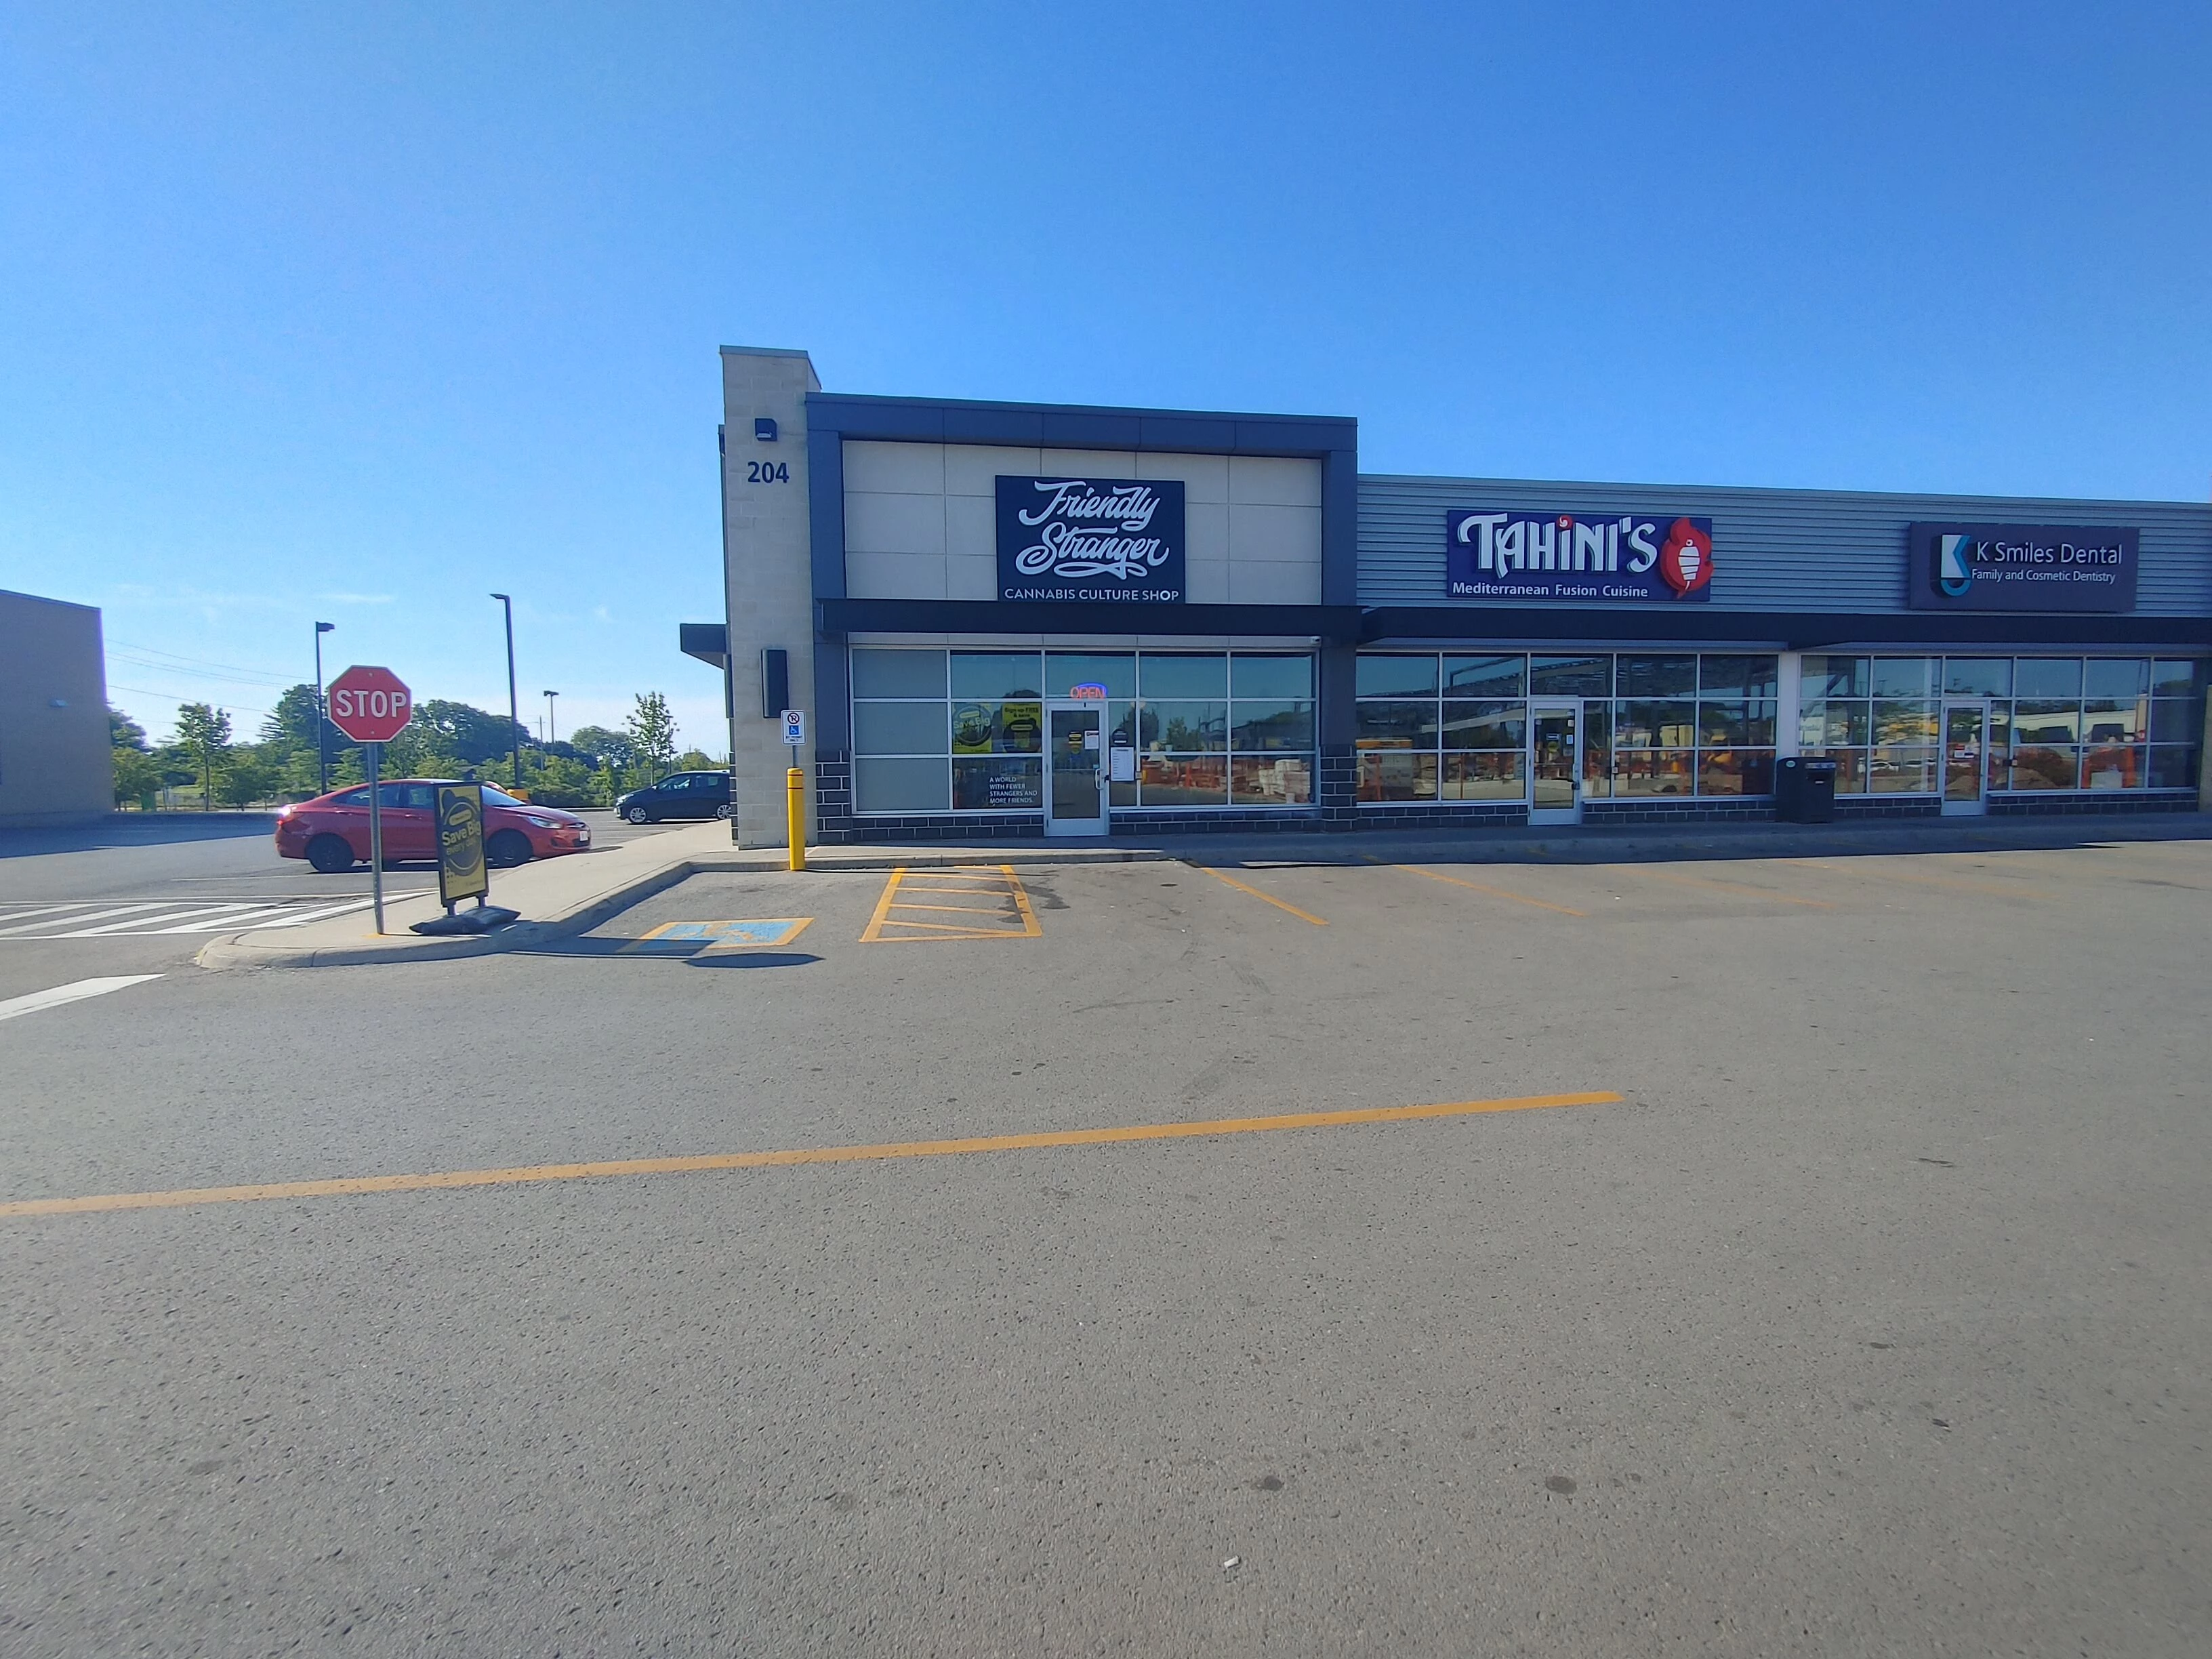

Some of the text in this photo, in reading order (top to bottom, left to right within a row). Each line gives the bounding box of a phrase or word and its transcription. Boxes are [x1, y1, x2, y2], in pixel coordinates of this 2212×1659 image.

[747, 462, 790, 483] 204
[1018, 480, 1161, 531] Friendly
[1015, 522, 1170, 580] Stranger
[1975, 541, 2123, 565] K Smiles Dental
[1971, 569, 2116, 585] Family and Cosmetic Dentistry
[1004, 588, 1179, 601] CANNABIS CULTURE SHOP
[1452, 581, 1648, 598] Mediterranean Fusion Cuisine
[1070, 686, 1107, 699] OPEN
[335, 689, 407, 718] STOP
[953, 720, 975, 729] Save
[441, 819, 482, 846] Save Big
